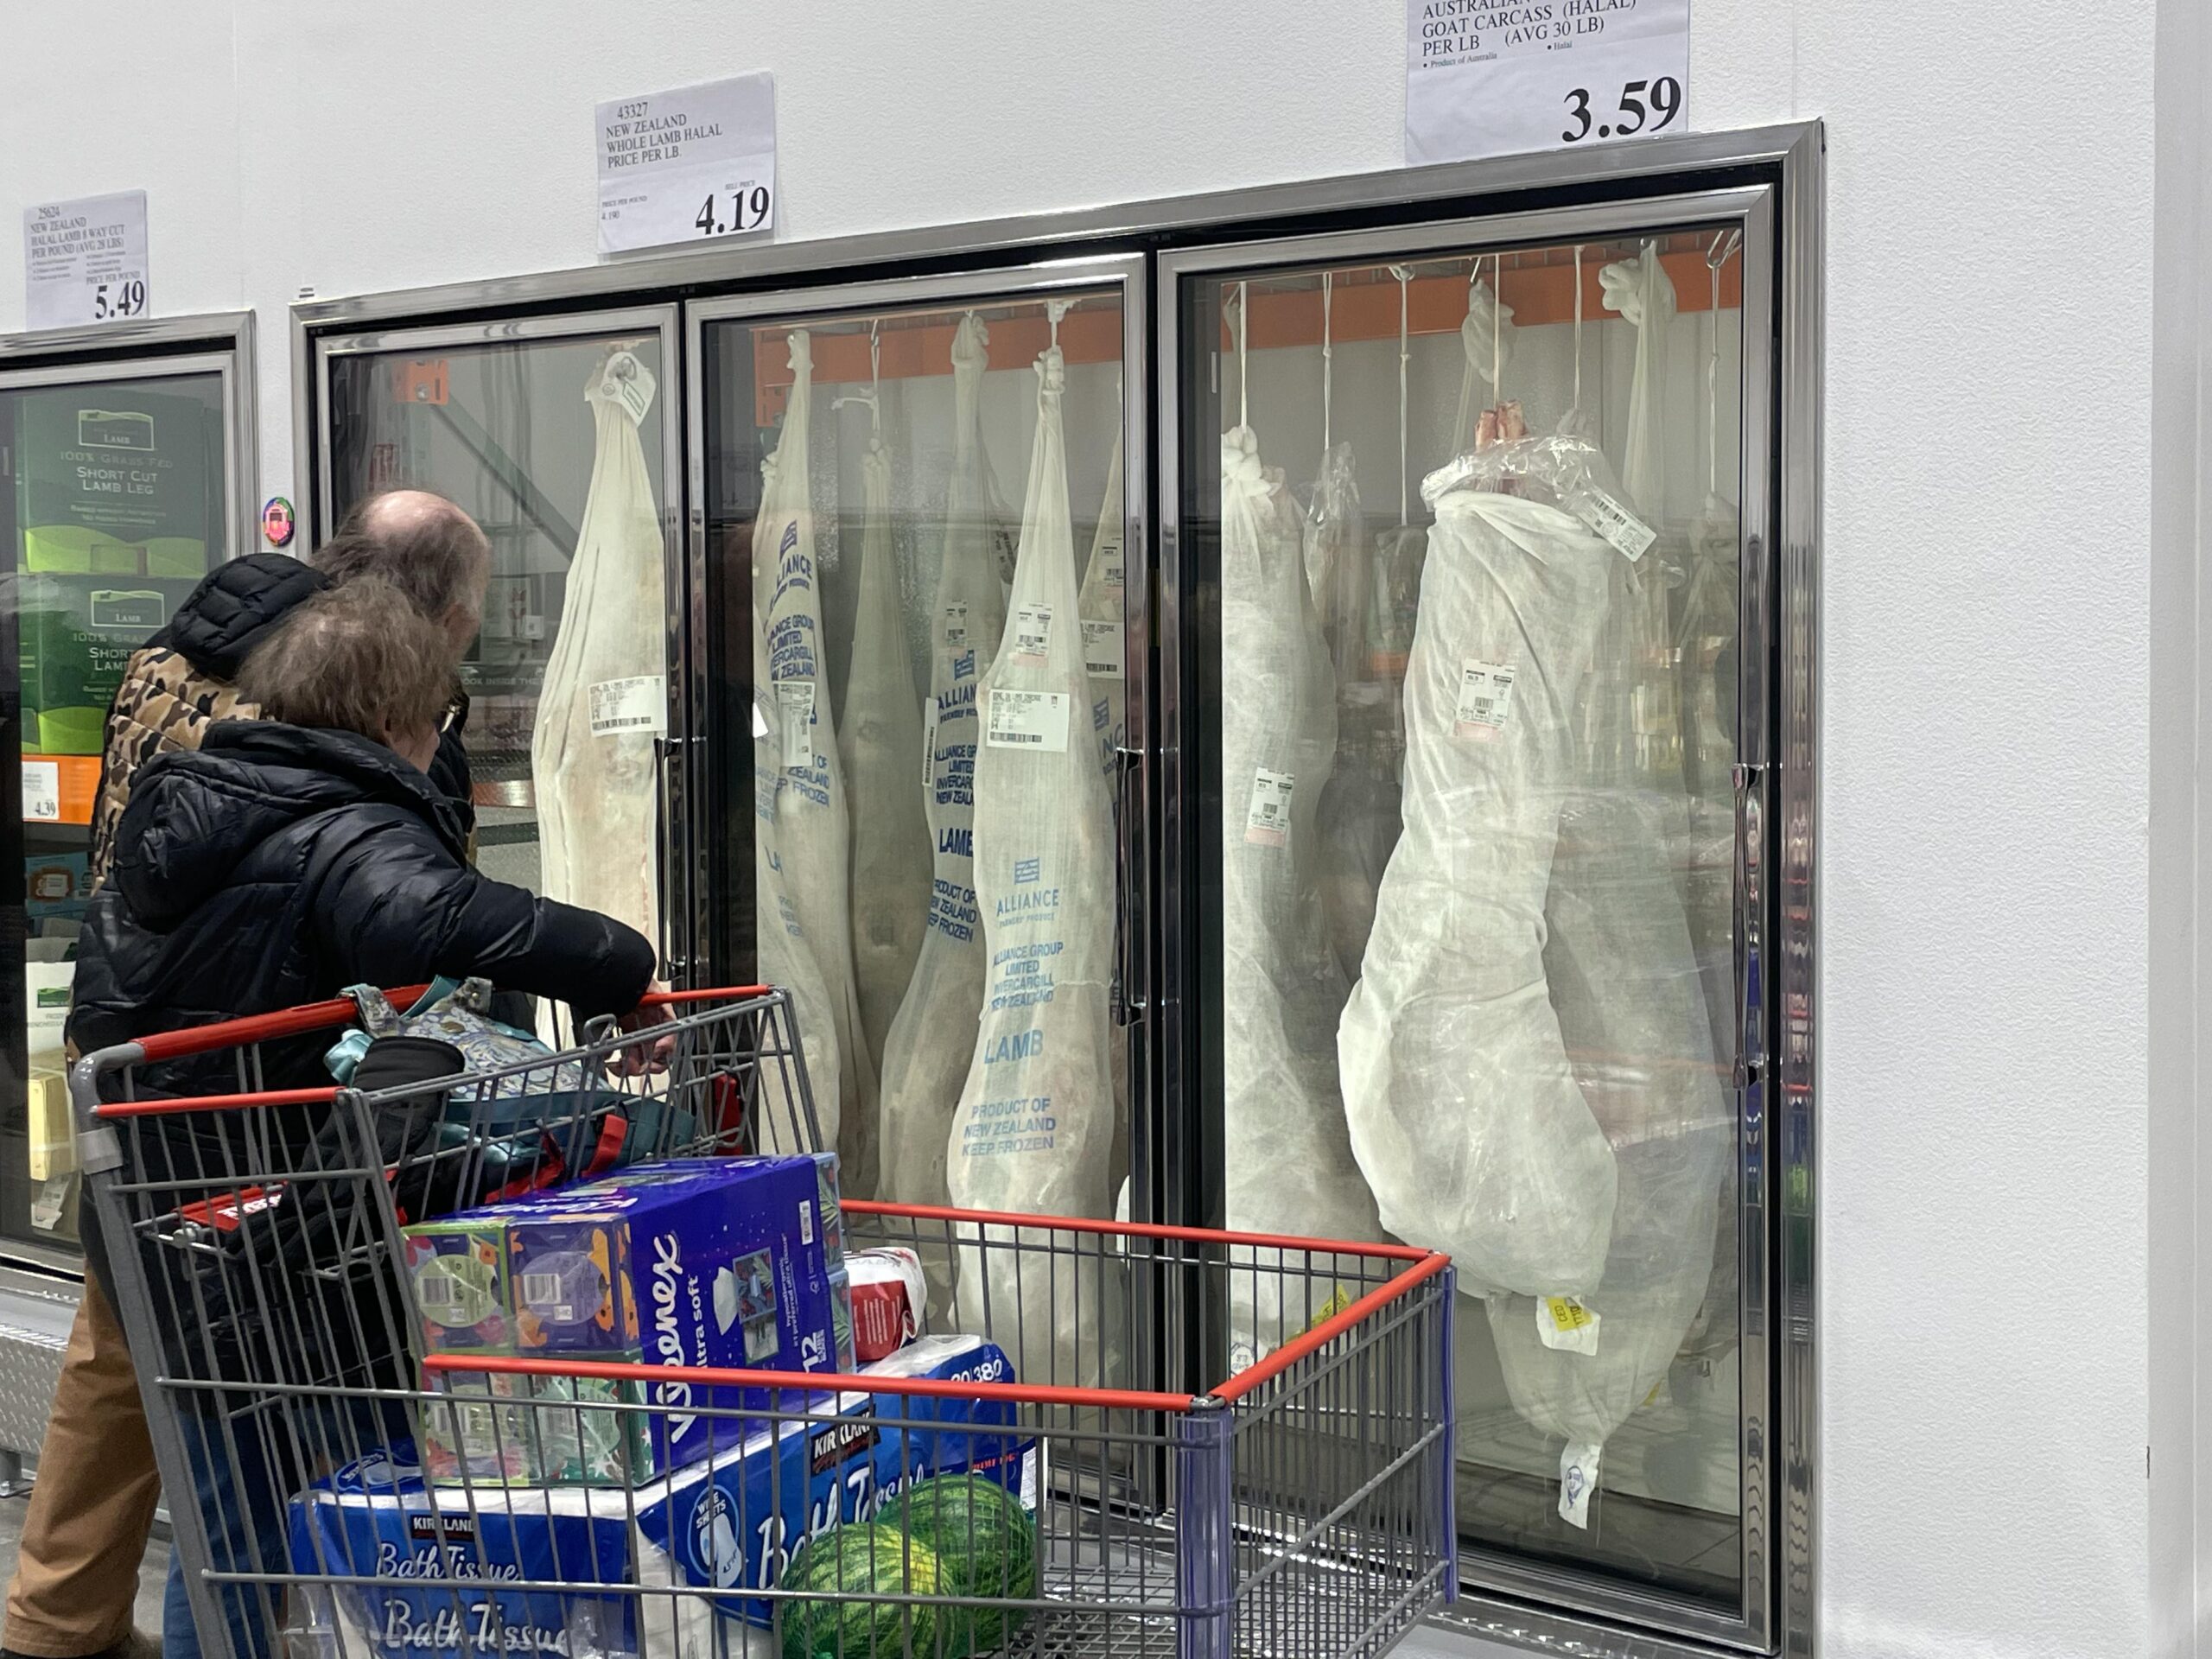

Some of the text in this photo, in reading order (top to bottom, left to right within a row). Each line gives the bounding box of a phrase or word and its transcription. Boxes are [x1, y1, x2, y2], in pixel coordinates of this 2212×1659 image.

[1423, 0, 1529, 19] AUSTRALI
[1423, 0, 1636, 38] GOAT CARCASS (HALAL)
[1422, 16, 1605, 57] PER LB (AVG 30 LB)
[1554, 41, 1573, 51] Halal
[1430, 58, 1456, 68] Product
[1468, 52, 1497, 62] Australia
[617, 102, 648, 119] 43327
[1561, 76, 1681, 143] 3.59
[606, 113, 687, 139] NEW ZEALAND
[607, 124, 723, 153] WHOLE LAMB HALAL
[607, 152, 639, 168] PRICE
[642, 149, 662, 163] PER
[696, 187, 770, 235] 4.19
[30, 217, 87, 233] NEW ZEALAND
[31, 235, 56, 246] HALAL
[59, 230, 81, 242] LAMB
[88, 227, 108, 238] WAY
[108, 224, 125, 236] CUT
[32, 247, 47, 259] PER
[48, 243, 75, 257] POUND
[76, 241, 96, 255] (AVG
[106, 237, 125, 249] LBS)
[86, 270, 141, 285] PRICE PER POUND
[95, 280, 145, 320] 5.49
[60, 450, 94, 462] 100%
[777, 553, 812, 590] LIANCE
[772, 630, 802, 654] LIMITED
[781, 663, 815, 679] ZEALAND
[938, 683, 977, 710] ALLIAN
[817, 754, 828, 769] OF
[934, 745, 966, 762] ALLIANCE
[787, 766, 830, 790] ZEALAND
[792, 782, 830, 807] FROZEN
[936, 790, 974, 806] NEW ZEALA
[963, 889, 976, 905] OF
[996, 889, 1059, 918] ALLIANCE
[939, 898, 977, 924] ZEALAND
[938, 917, 974, 943] FROZEN
[993, 942, 1064, 967] ALLIANCE GROUP
[1006, 960, 1040, 976] LIMITED
[994, 973, 1054, 995] INVERCARGILL
[1007, 990, 1053, 1009] ZEALAND
[984, 1029, 1044, 1064] LAMB
[971, 1097, 1051, 1119] PRODUCT OF
[964, 1117, 1056, 1139] NEW ZEALAND
[962, 1135, 1054, 1156] KEEP FROZEN
[687, 1274, 708, 1369] ltra soft
[1554, 1305, 1568, 1322] CED
[801, 1332, 817, 1374] 12
[696, 1499, 727, 1529] SHETS
[697, 1491, 719, 1515] WIE
[413, 1516, 474, 1533] KIRLAN
[376, 1543, 446, 1579] Bath
[384, 1599, 468, 1649] Bath
